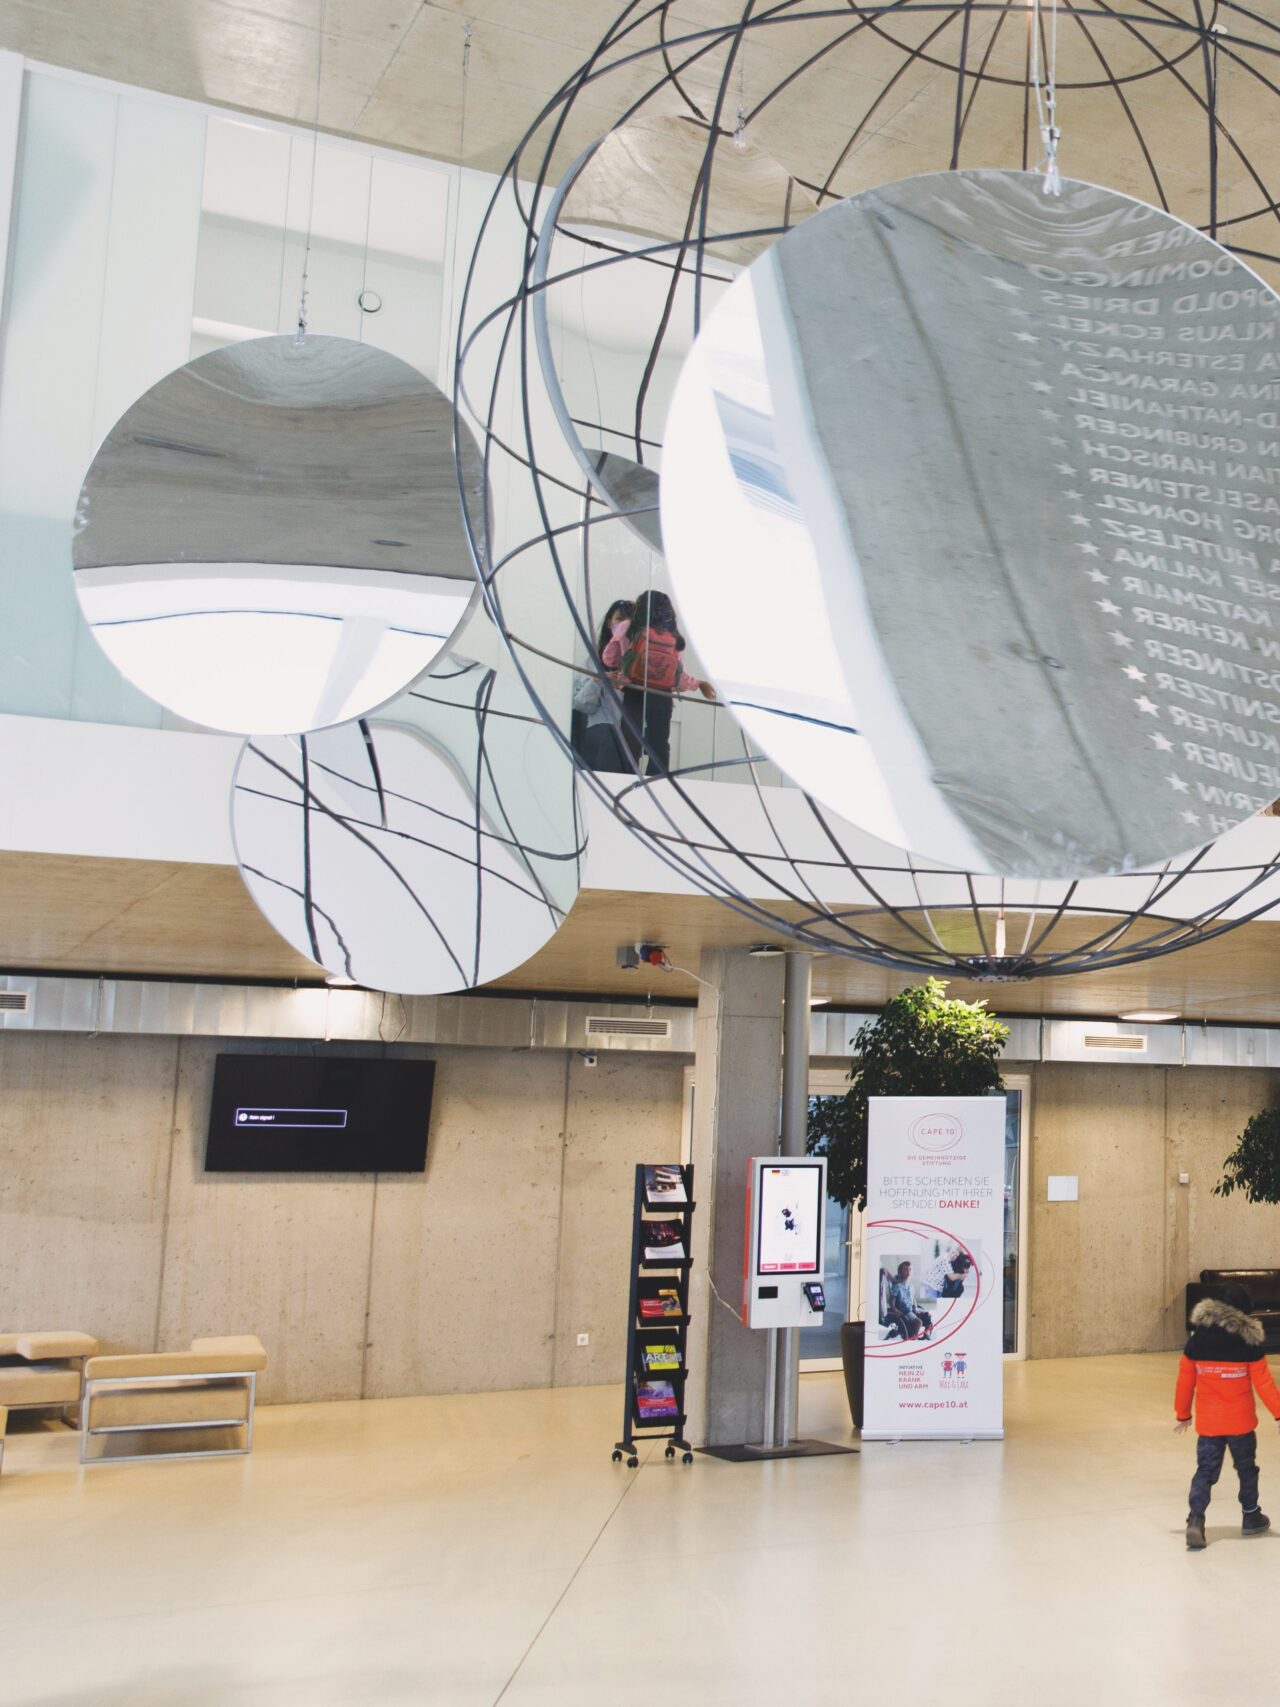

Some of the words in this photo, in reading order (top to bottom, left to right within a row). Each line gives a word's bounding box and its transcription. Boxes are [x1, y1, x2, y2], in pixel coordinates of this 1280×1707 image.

[920, 1128, 944, 1136] CAPE
[945, 1128, 956, 1136] 10
[882, 1176, 915, 1186] BITTE
[915, 1176, 972, 1186] SCHENKEN
[974, 1176, 990, 1186] SIE
[879, 1188, 940, 1198] HOFFNUNG
[942, 1188, 961, 1198] MIT
[963, 1188, 993, 1198] IHRER
[892, 1199, 937, 1209] SPENDE!
[939, 1199, 980, 1209] DANKE!
[898, 1400, 968, 1410] www.cape10.at
